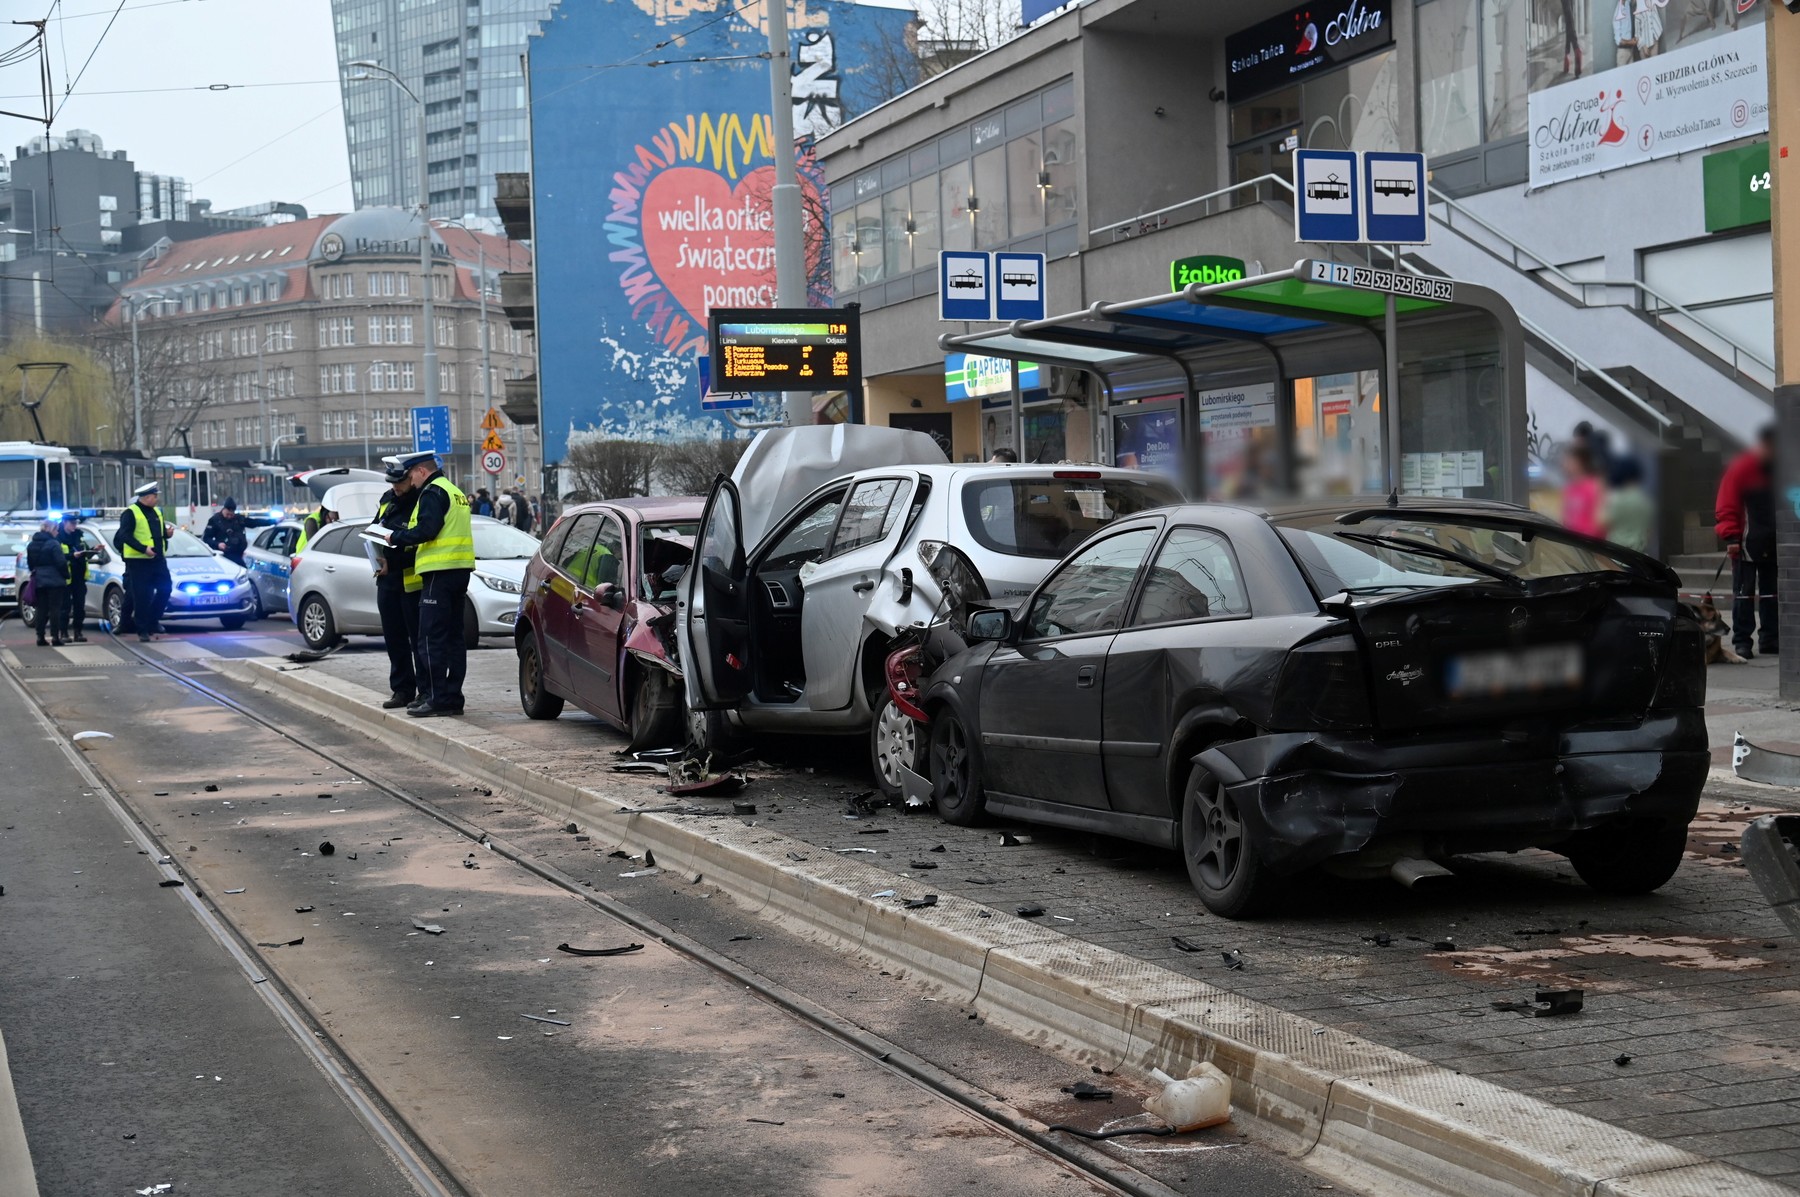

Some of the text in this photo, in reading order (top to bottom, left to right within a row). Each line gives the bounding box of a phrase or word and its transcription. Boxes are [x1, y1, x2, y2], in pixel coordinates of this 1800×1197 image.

[1325, 0, 1381, 46] Astra
[1655, 52, 1740, 86] SIEDZIBA GŁÓWNA
[1666, 78, 1709, 99] Wyzwolenia
[1724, 63, 1757, 80] Szczecin
[1573, 98, 1599, 112] Grupa
[1535, 103, 1600, 148] Astra
[1657, 117, 1721, 141] AstraSzkolaTanca
[659, 195, 723, 231] wielka
[1318, 264, 1451, 299] 2 12 522 523 525 530 532
[745, 325, 805, 336] Lubomirskiego
[826, 337, 847, 346] Odjazd
[979, 357, 1011, 377] APTEKA
[1201, 391, 1245, 406] Lubomirskiego
[486, 456, 502, 468] 30
[1375, 640, 1403, 649] OPEL
